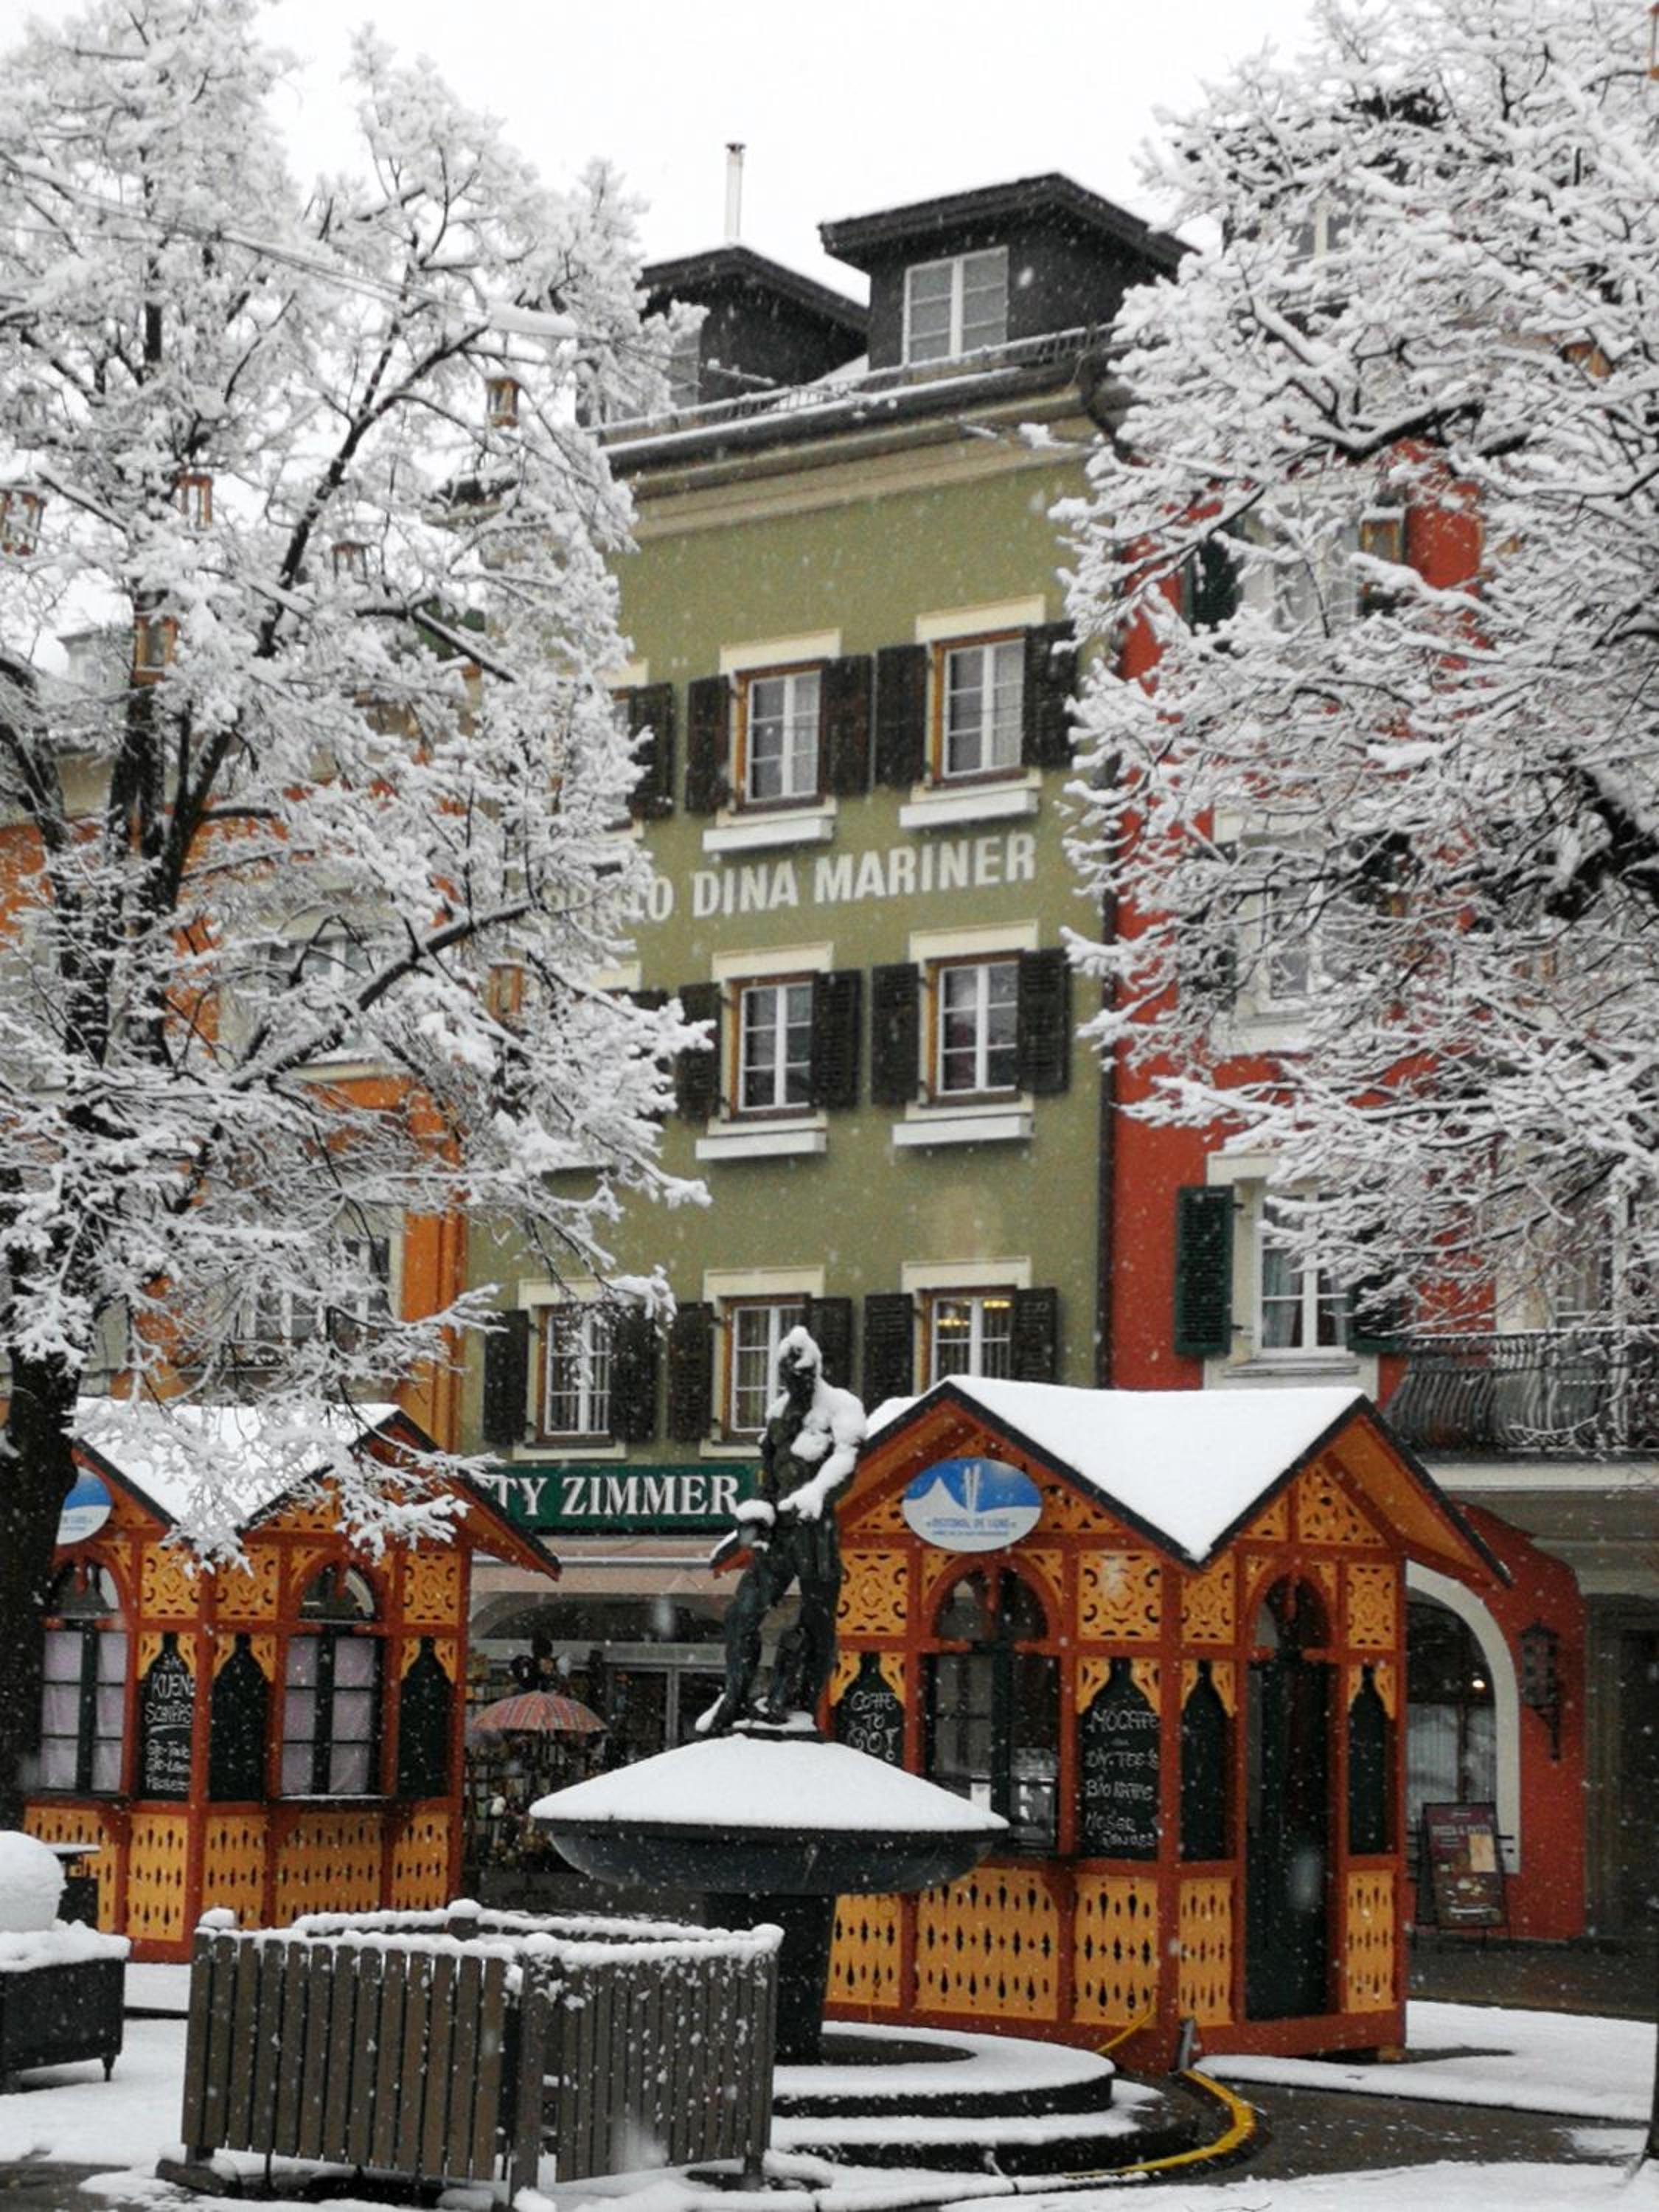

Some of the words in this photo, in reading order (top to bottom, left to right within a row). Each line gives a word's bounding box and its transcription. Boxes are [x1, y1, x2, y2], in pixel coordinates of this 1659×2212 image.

[692, 860, 799, 918] DINA
[814, 831, 1036, 904] MARINER
[560, 1475, 740, 1516] ZIMMER
